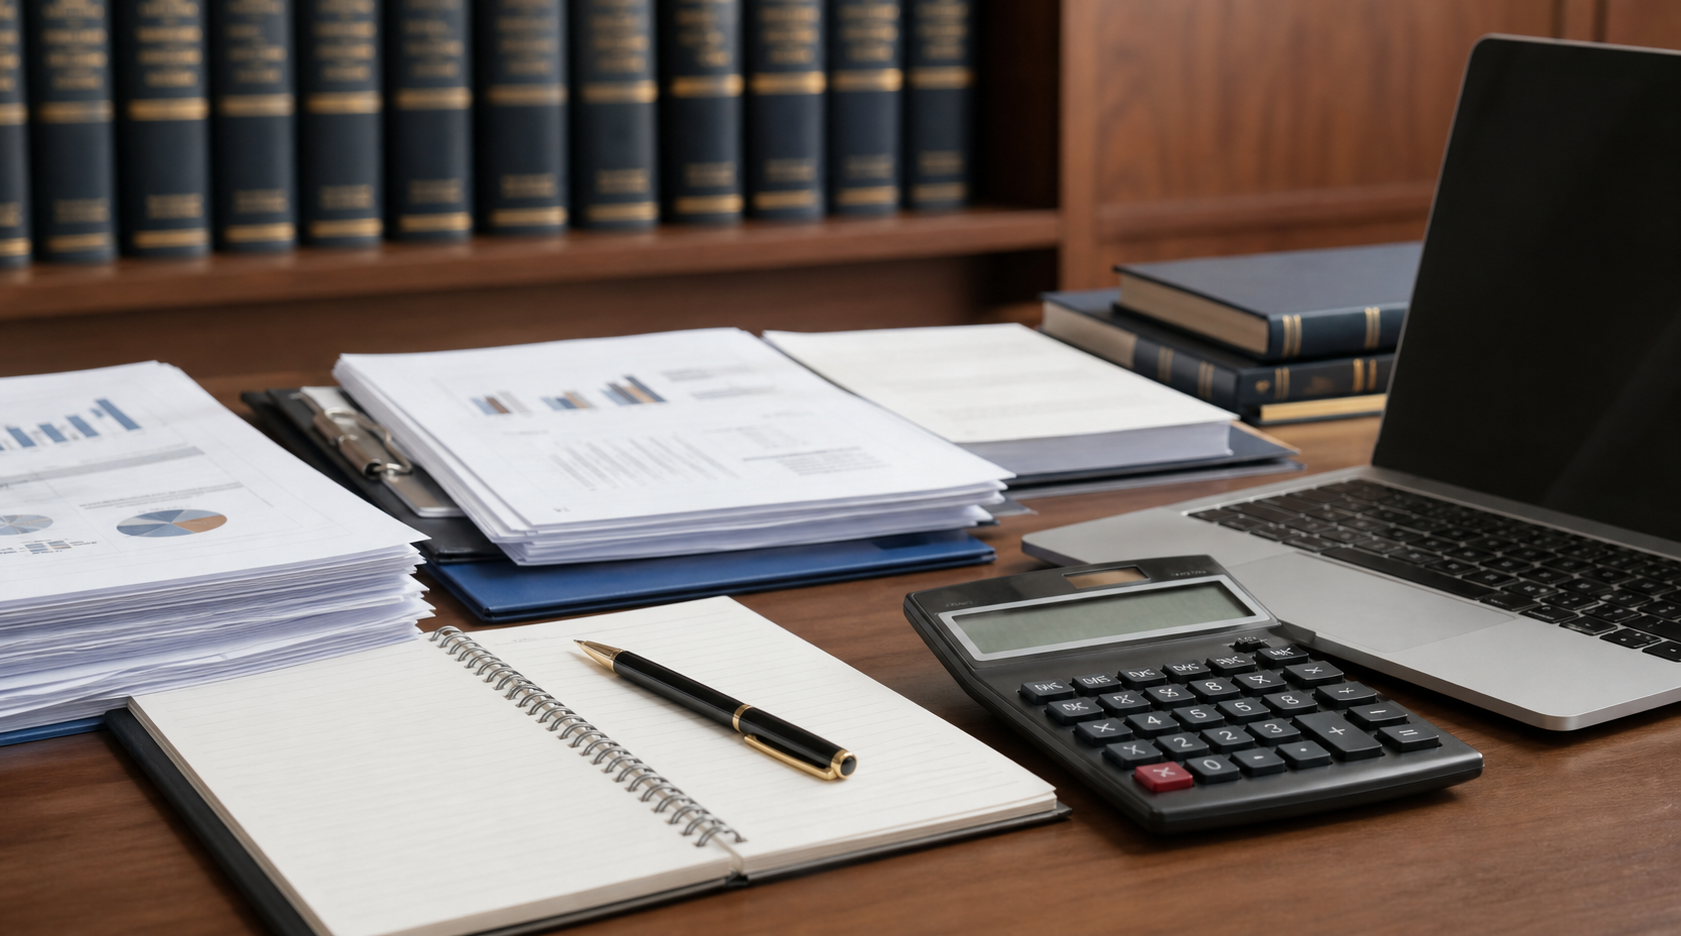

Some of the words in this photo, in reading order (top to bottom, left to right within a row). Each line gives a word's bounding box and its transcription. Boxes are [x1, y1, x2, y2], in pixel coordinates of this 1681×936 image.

[1205, 681, 1223, 691] 8
[1234, 701, 1252, 712] 5
[1189, 708, 1207, 719] 5
[1147, 715, 1162, 725] 4
[1264, 723, 1283, 734] 3
[1219, 730, 1238, 741] 2
[1173, 736, 1193, 748] 2
[1203, 759, 1222, 771] 0
